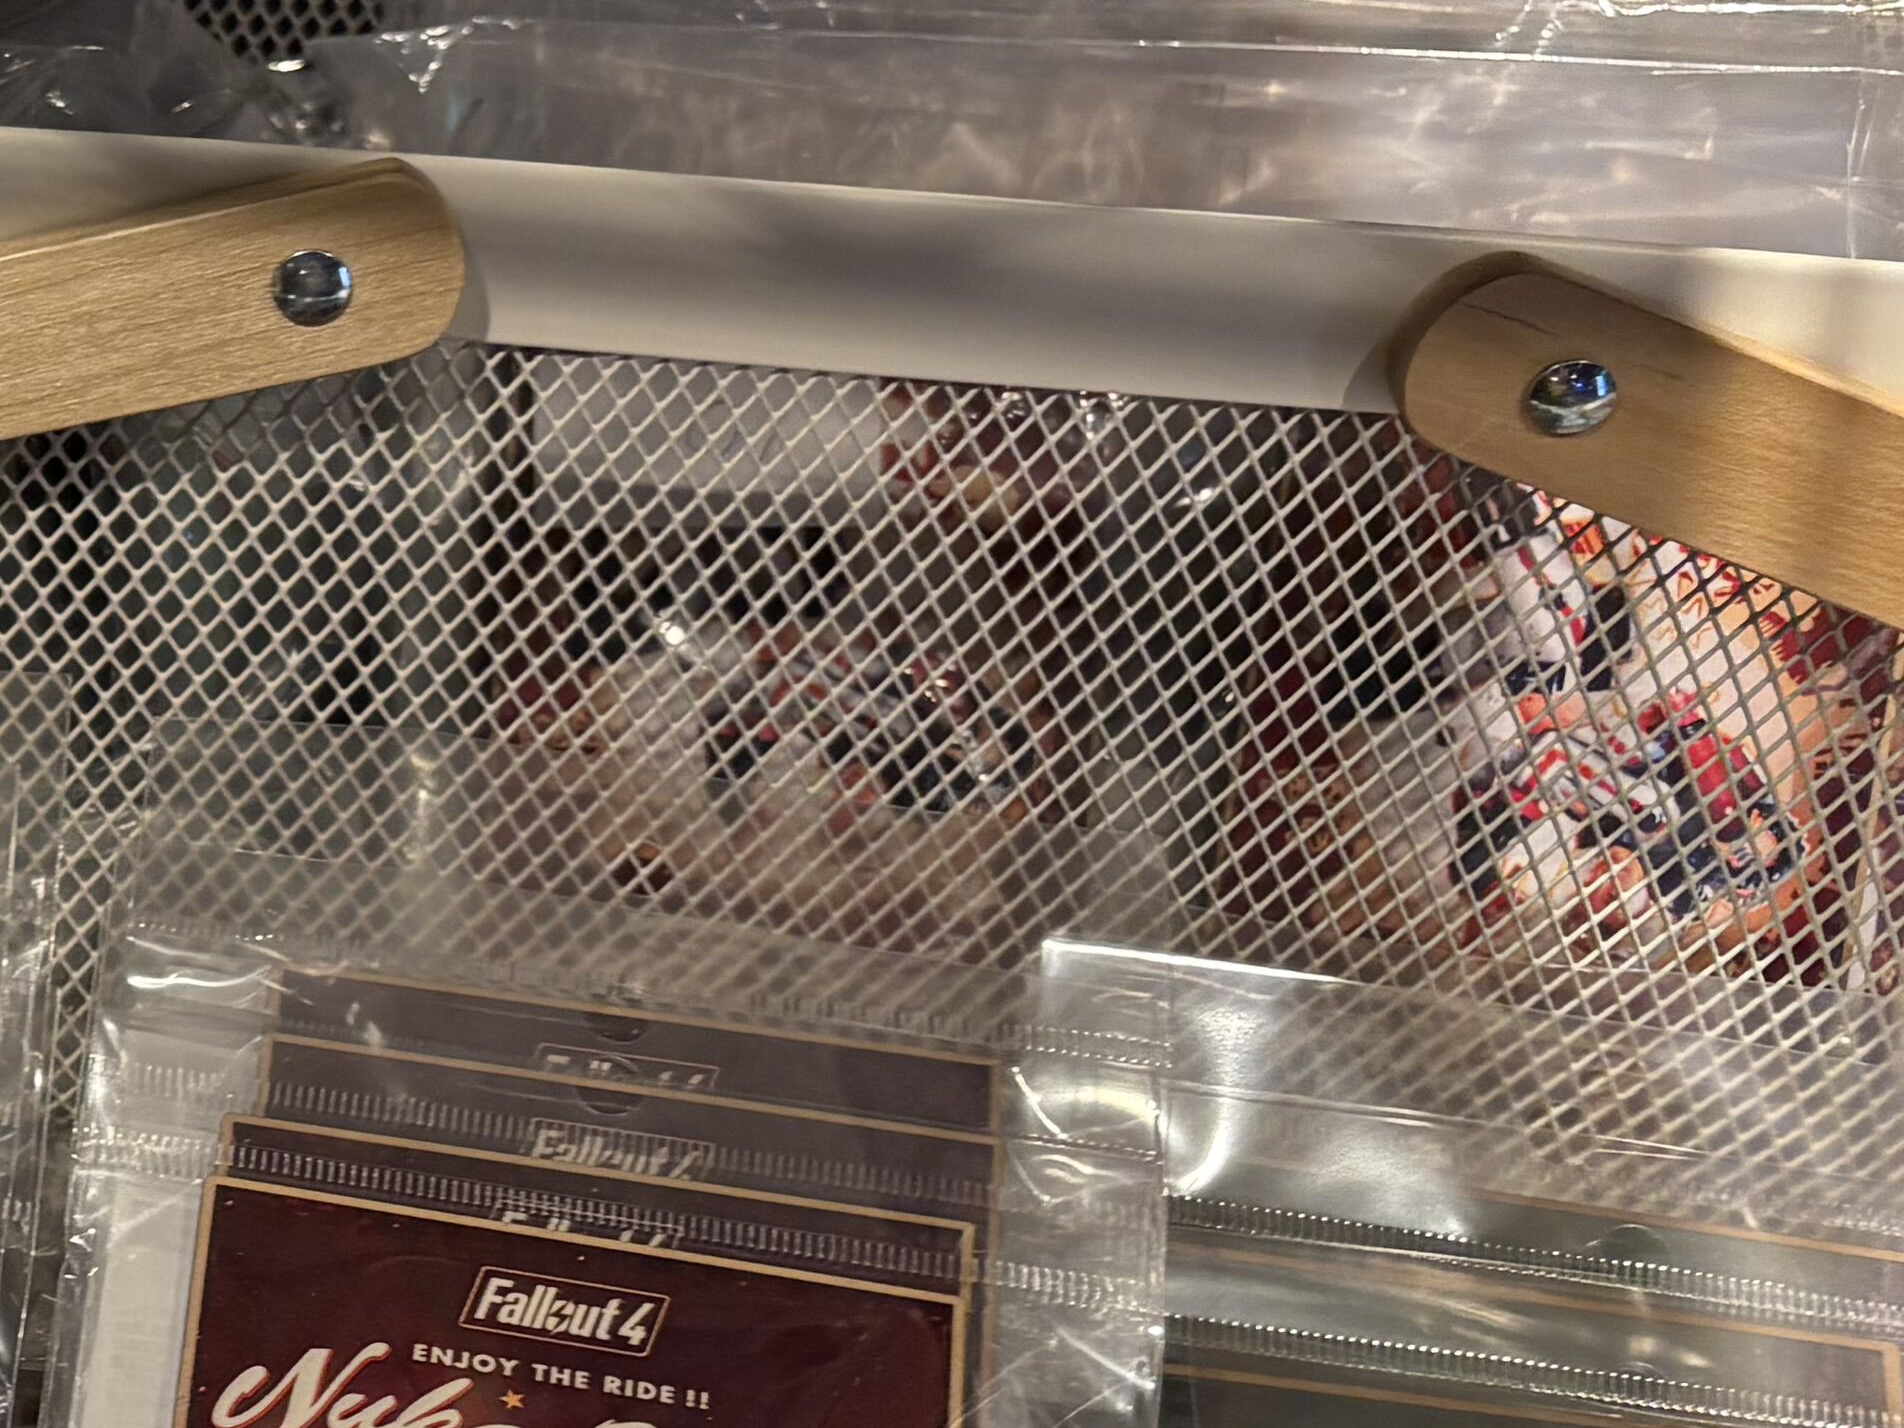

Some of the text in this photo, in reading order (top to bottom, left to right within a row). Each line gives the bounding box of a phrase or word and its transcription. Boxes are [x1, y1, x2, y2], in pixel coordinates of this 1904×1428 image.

[473, 1277, 656, 1347] Fallout 4
[411, 1343, 711, 1411] ENJOY THE RIDE !!
